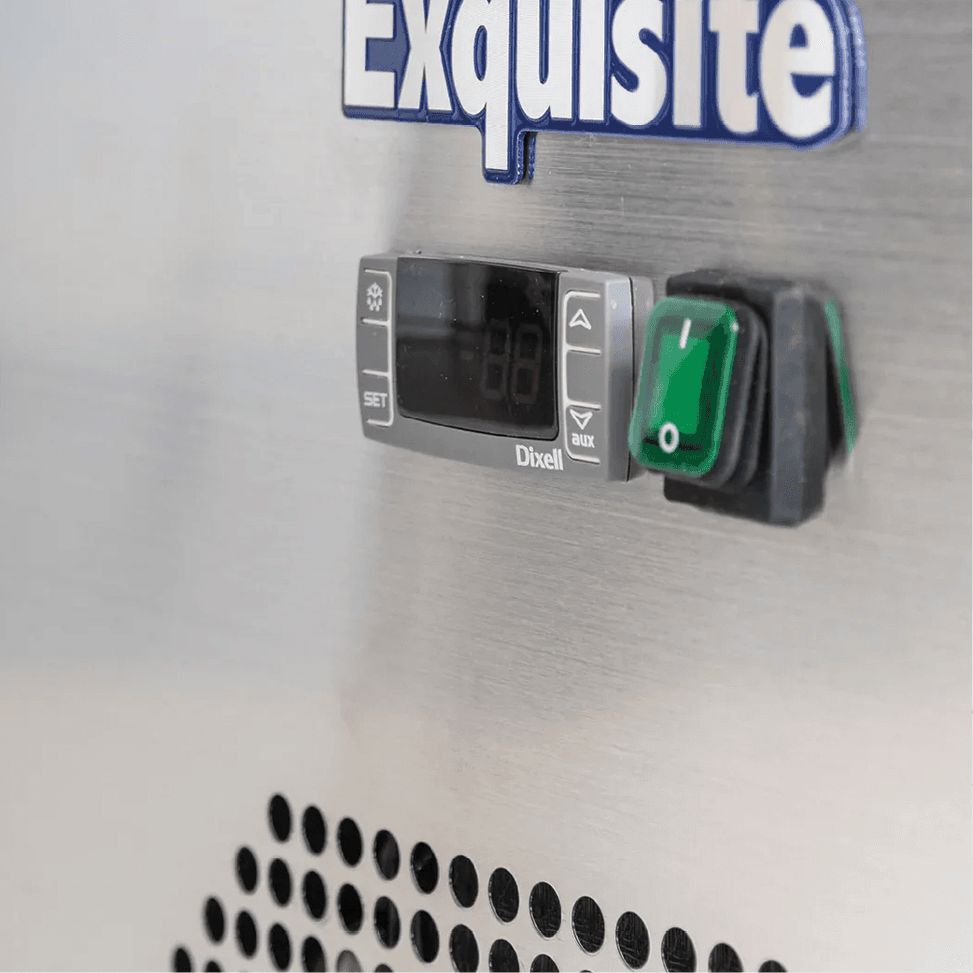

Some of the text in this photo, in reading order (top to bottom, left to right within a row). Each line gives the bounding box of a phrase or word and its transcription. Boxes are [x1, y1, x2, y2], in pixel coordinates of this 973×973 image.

[363, 391, 388, 408] SET
[571, 432, 596, 449] aux
[515, 444, 565, 472] Dixell
